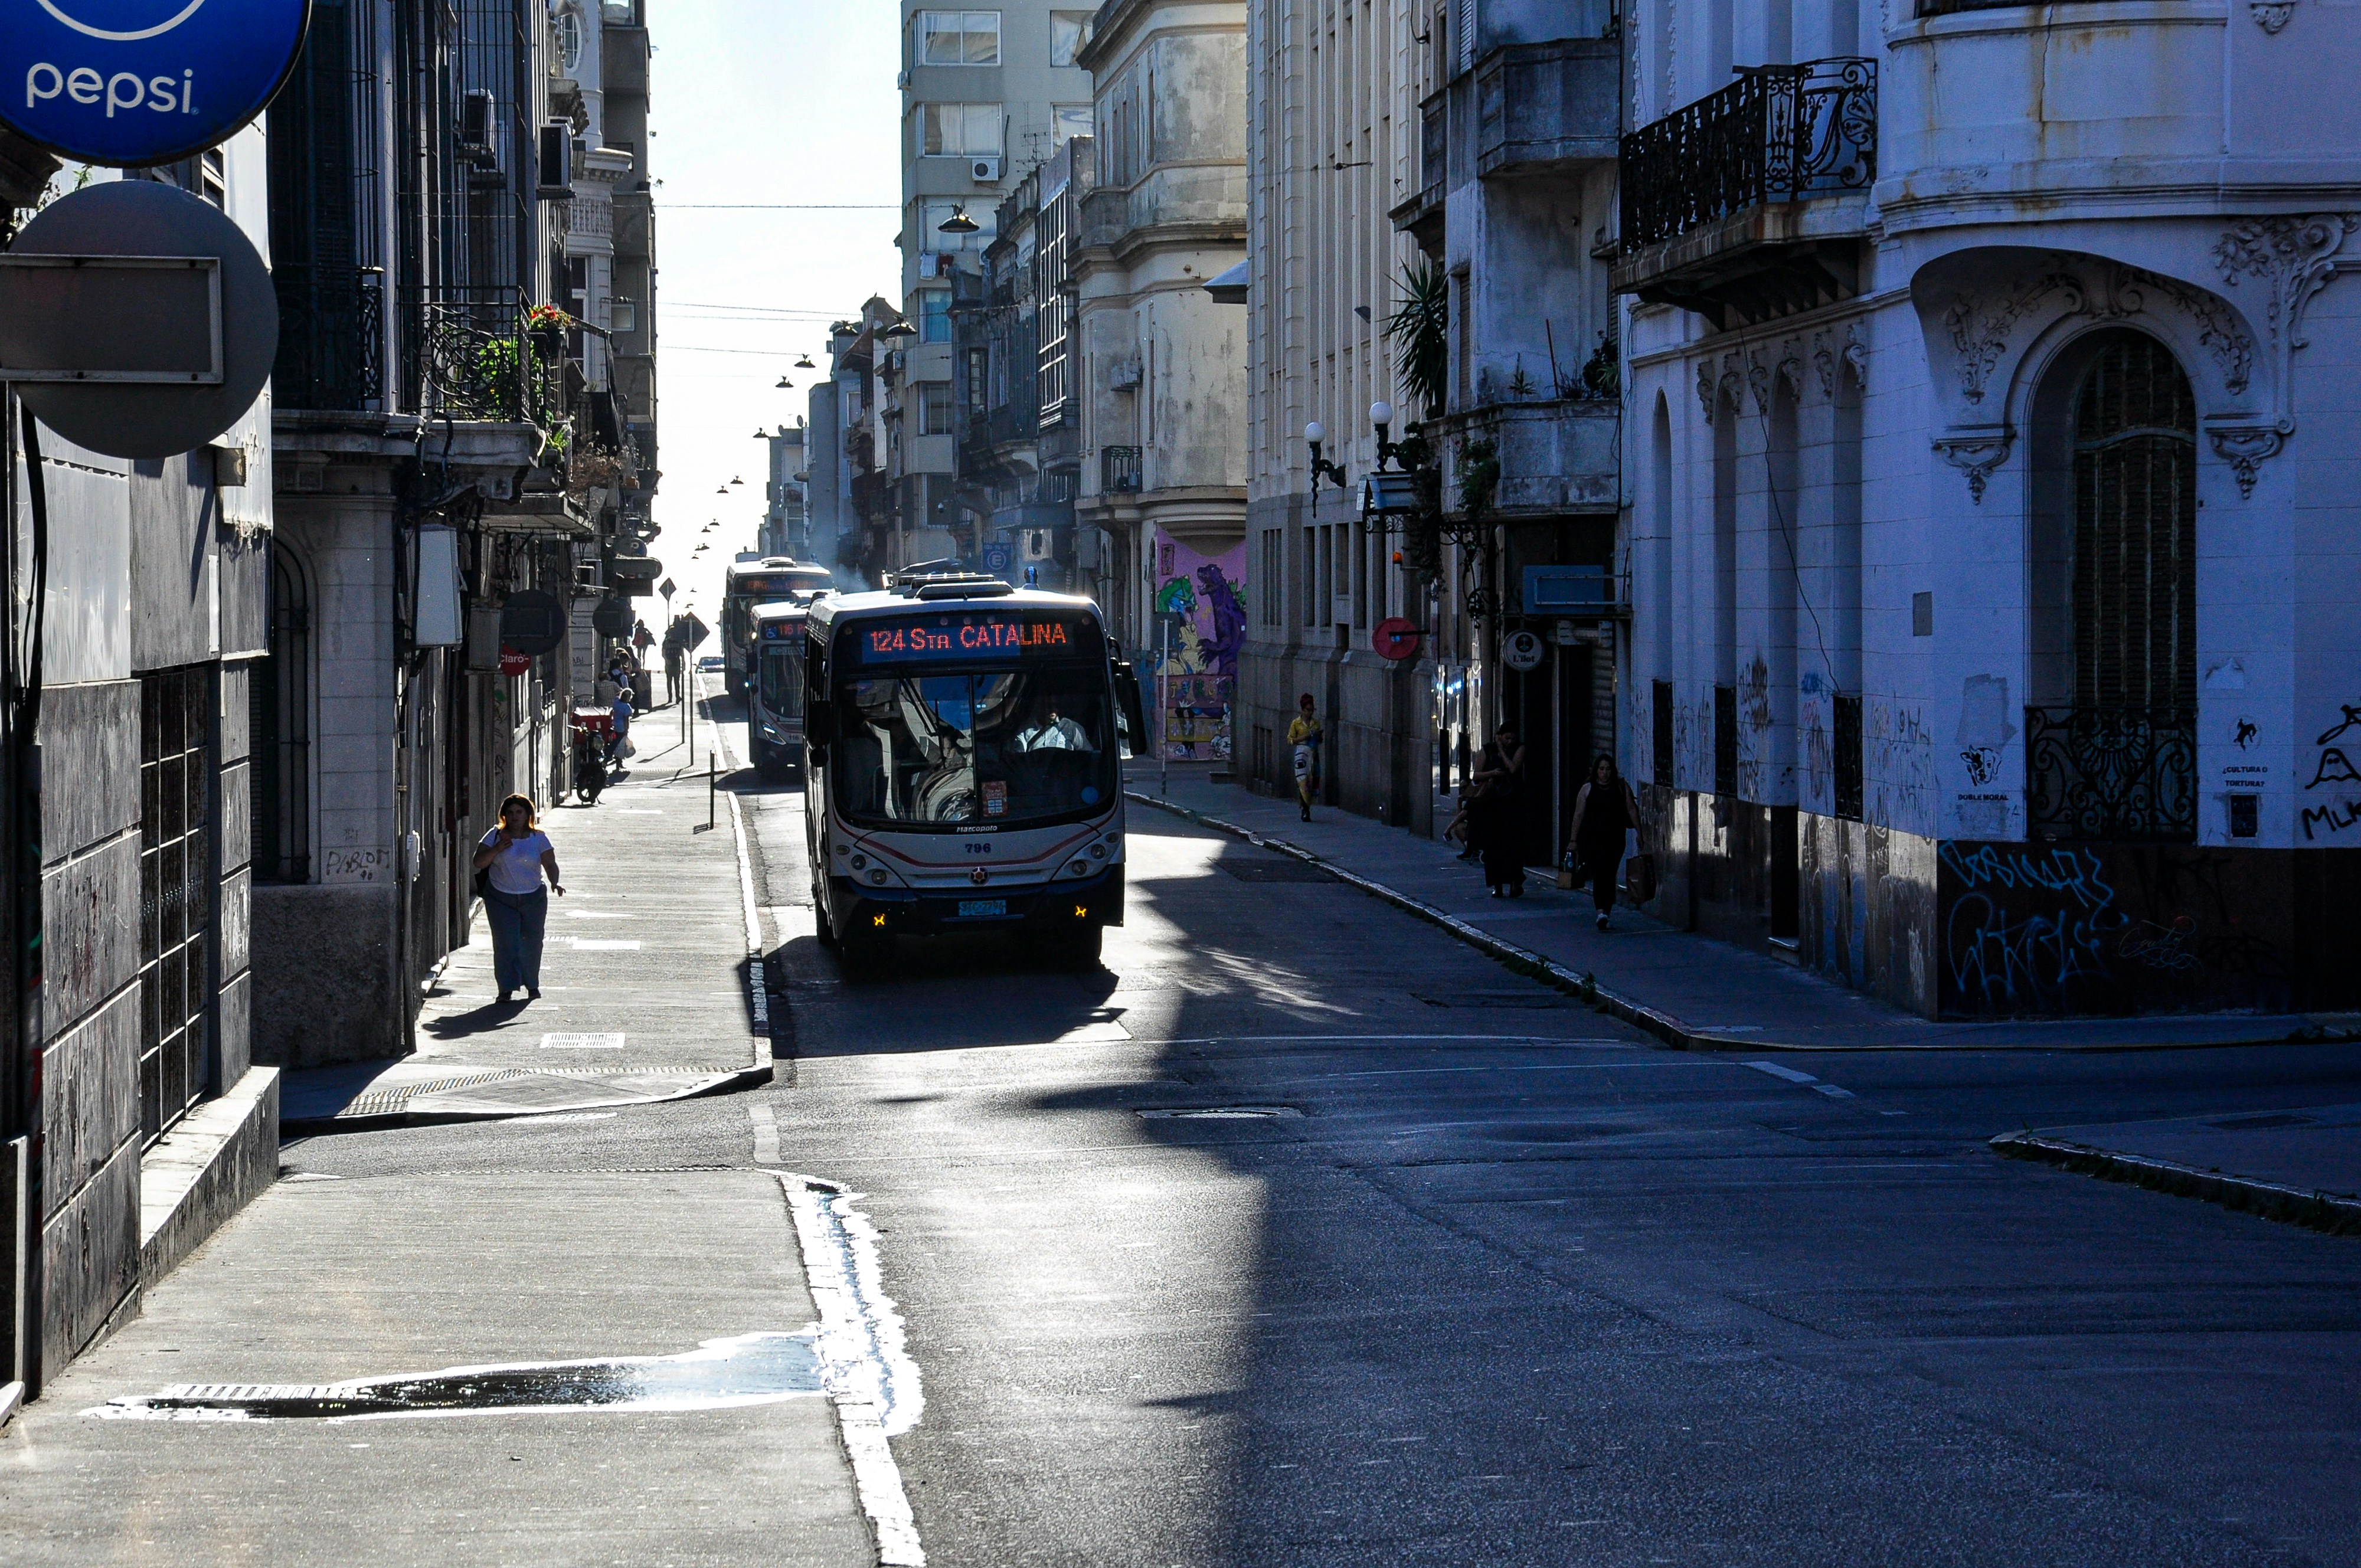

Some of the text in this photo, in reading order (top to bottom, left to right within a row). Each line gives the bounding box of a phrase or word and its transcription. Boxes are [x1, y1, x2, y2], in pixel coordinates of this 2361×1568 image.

[27, 63, 192, 118] pepsi
[871, 629, 905, 652] 124
[960, 623, 1067, 647] CATALINA
[964, 843, 991, 853] 796
